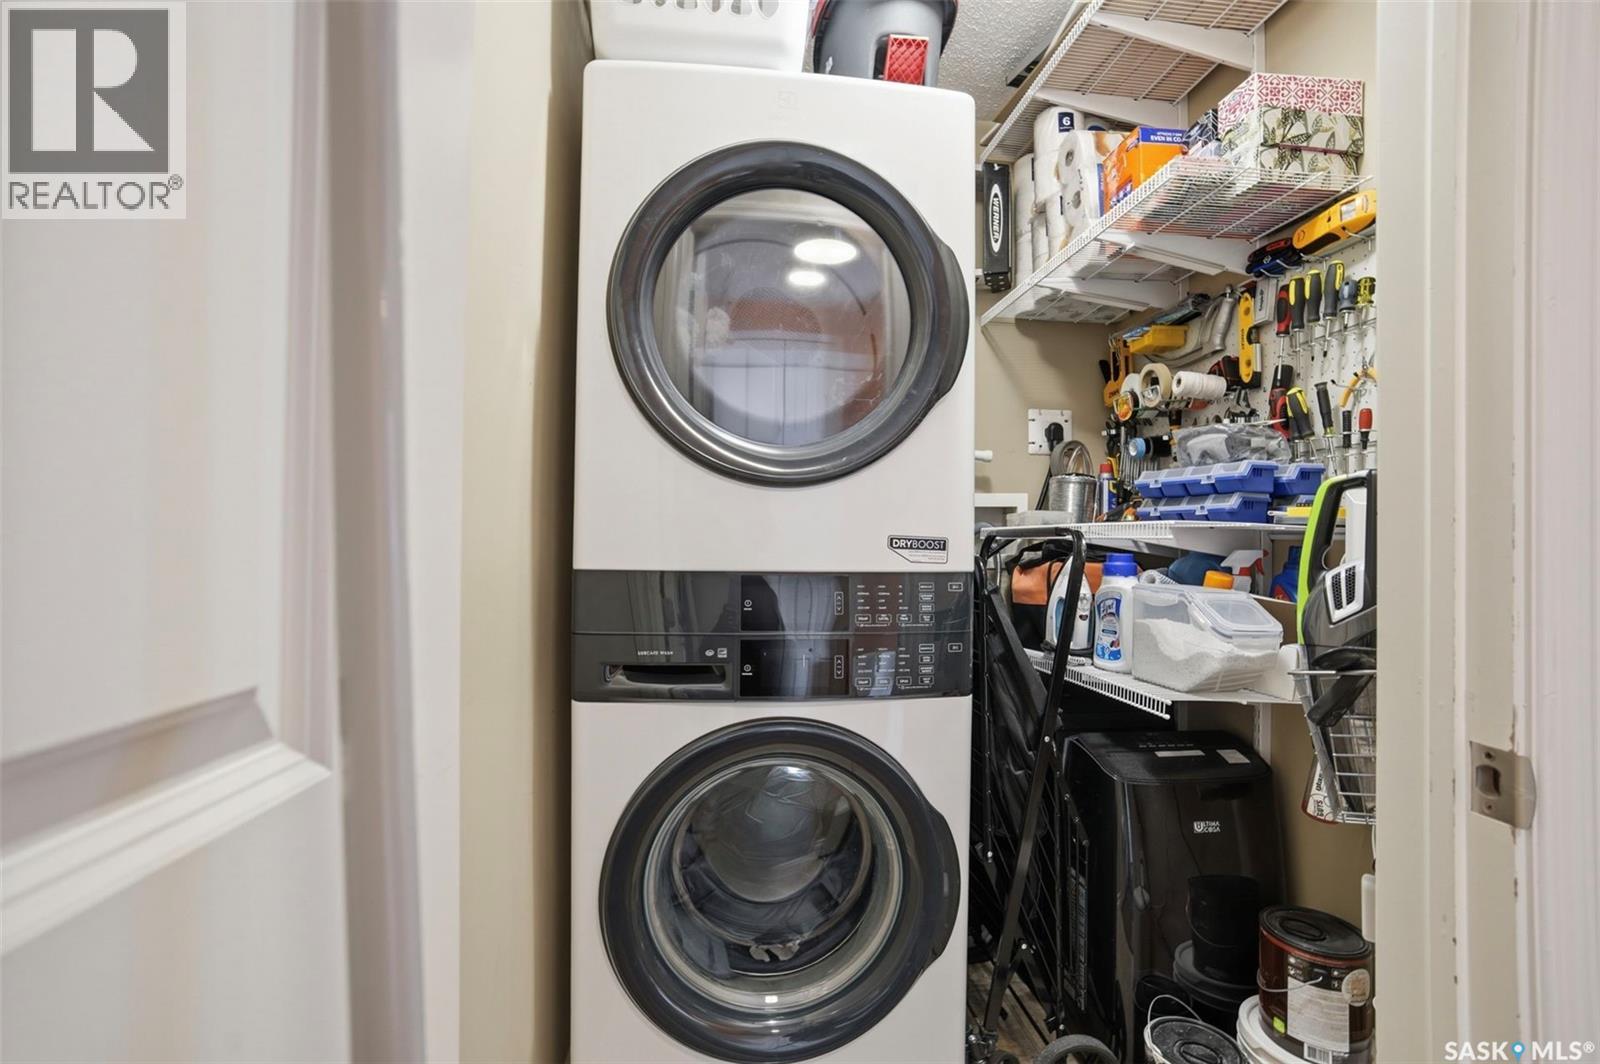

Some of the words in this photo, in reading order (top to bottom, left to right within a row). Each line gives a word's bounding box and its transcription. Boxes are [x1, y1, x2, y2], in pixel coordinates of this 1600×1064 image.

[1062, 116, 1071, 126] 6
[992, 197, 1000, 240] WERNER
[892, 539, 944, 549] DRYBOOST
